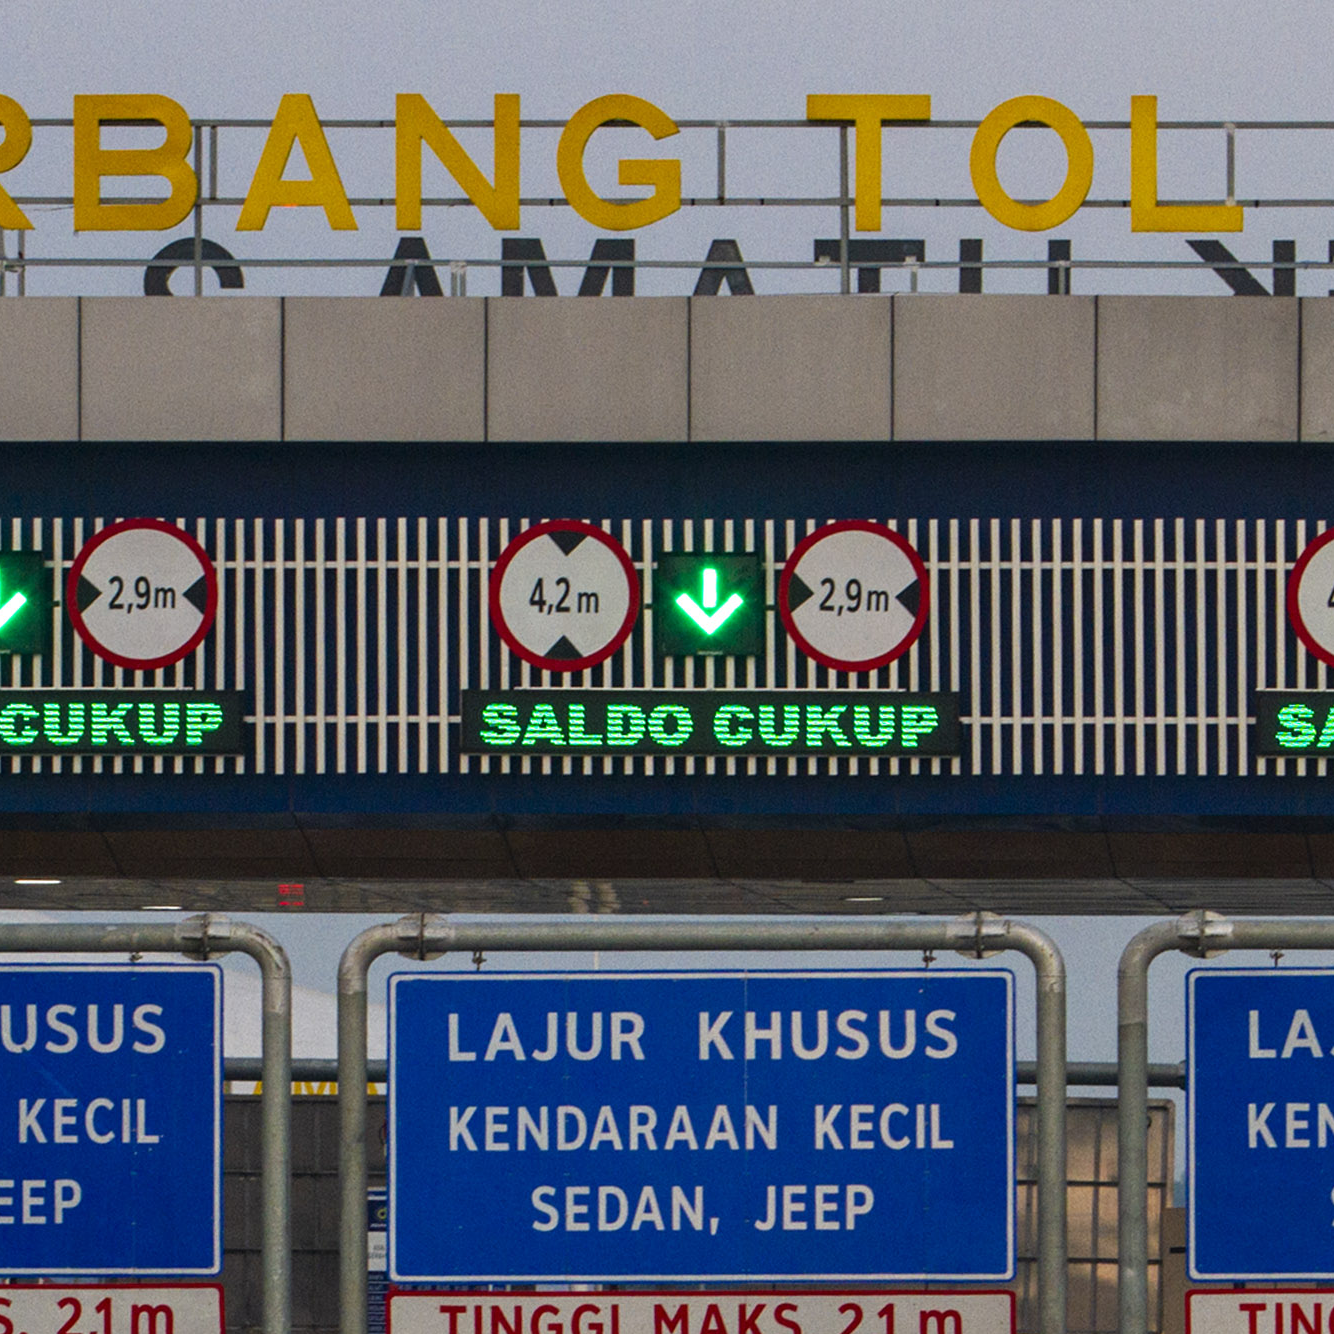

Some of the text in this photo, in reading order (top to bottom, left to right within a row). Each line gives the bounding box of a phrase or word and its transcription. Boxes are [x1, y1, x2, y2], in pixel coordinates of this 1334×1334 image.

[807, 94, 1243, 232] TOL
[0, 703, 223, 746] CUKUP
[480, 704, 939, 748] SALDO CUKUP
[448, 1009, 958, 1061] LAJUR KHUSUS
[18, 1098, 159, 1144] KECIL
[449, 1103, 954, 1151] KENDARAAN KECIL
[531, 1184, 874, 1235] SEDAN, JEEP
